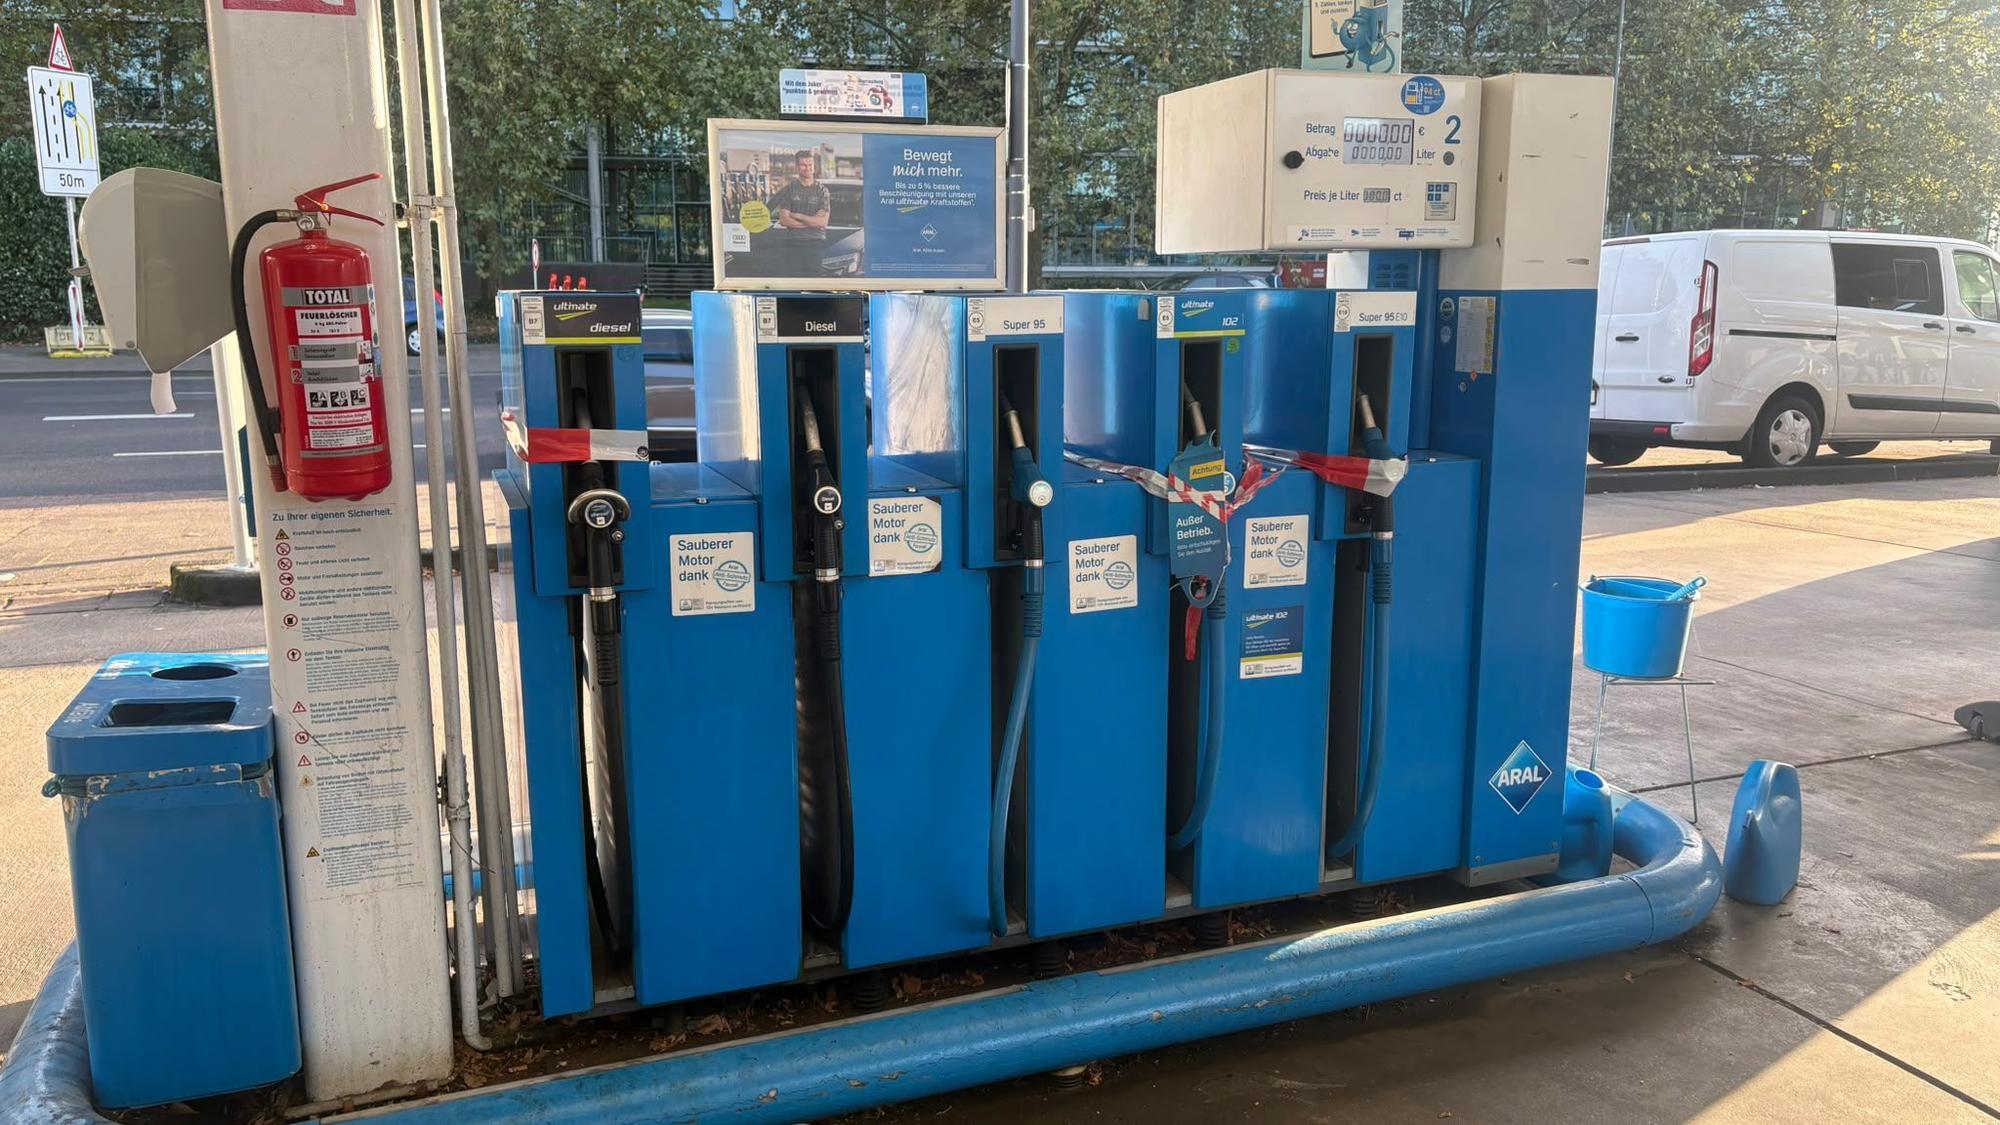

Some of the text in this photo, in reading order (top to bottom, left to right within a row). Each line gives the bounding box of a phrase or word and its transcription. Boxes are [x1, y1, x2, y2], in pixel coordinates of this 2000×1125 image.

[1306, 123, 1336, 135] Betrag
[1419, 127, 1425, 136] €
[1445, 115, 1461, 144] 2
[903, 149, 952, 163] Bewegt
[1417, 150, 1435, 159] Liter
[892, 163, 962, 177] mich mehr.
[879, 190, 934, 198] Beschleunigung
[1304, 190, 1360, 202] Preis je Liter
[1394, 192, 1402, 201] ct
[306, 289, 349, 304] TOTAL
[553, 302, 597, 311] ultimate
[1181, 300, 1214, 309] ultimate
[301, 310, 357, 319] FEUERLÖSCHER
[1359, 312, 1382, 323] Super
[805, 321, 836, 332] Diesel
[1003, 320, 1045, 331] Super 95
[1222, 317, 1238, 326] 102
[590, 322, 631, 333] diesel
[1192, 465, 1222, 476] Achtung
[873, 503, 923, 514] Sauberer
[272, 508, 392, 521] Zu Ihrer eigenen Sicherheit.
[874, 518, 906, 529] Motor
[1176, 515, 1204, 528] Außer
[1177, 526, 1213, 540] Betrieb.
[1251, 522, 1294, 533] Sauberer
[874, 532, 901, 543] dank
[1251, 536, 1279, 545] Motor
[678, 539, 733, 551] Sauberer
[1075, 543, 1120, 555] Sauberer
[1251, 549, 1273, 558] dank
[679, 555, 715, 566] Motor
[1076, 558, 1105, 569] Motor
[679, 569, 709, 582] dank
[1076, 571, 1100, 583] dank
[1246, 611, 1288, 621] ultimate 102
[1498, 765, 1543, 788] ARAL
